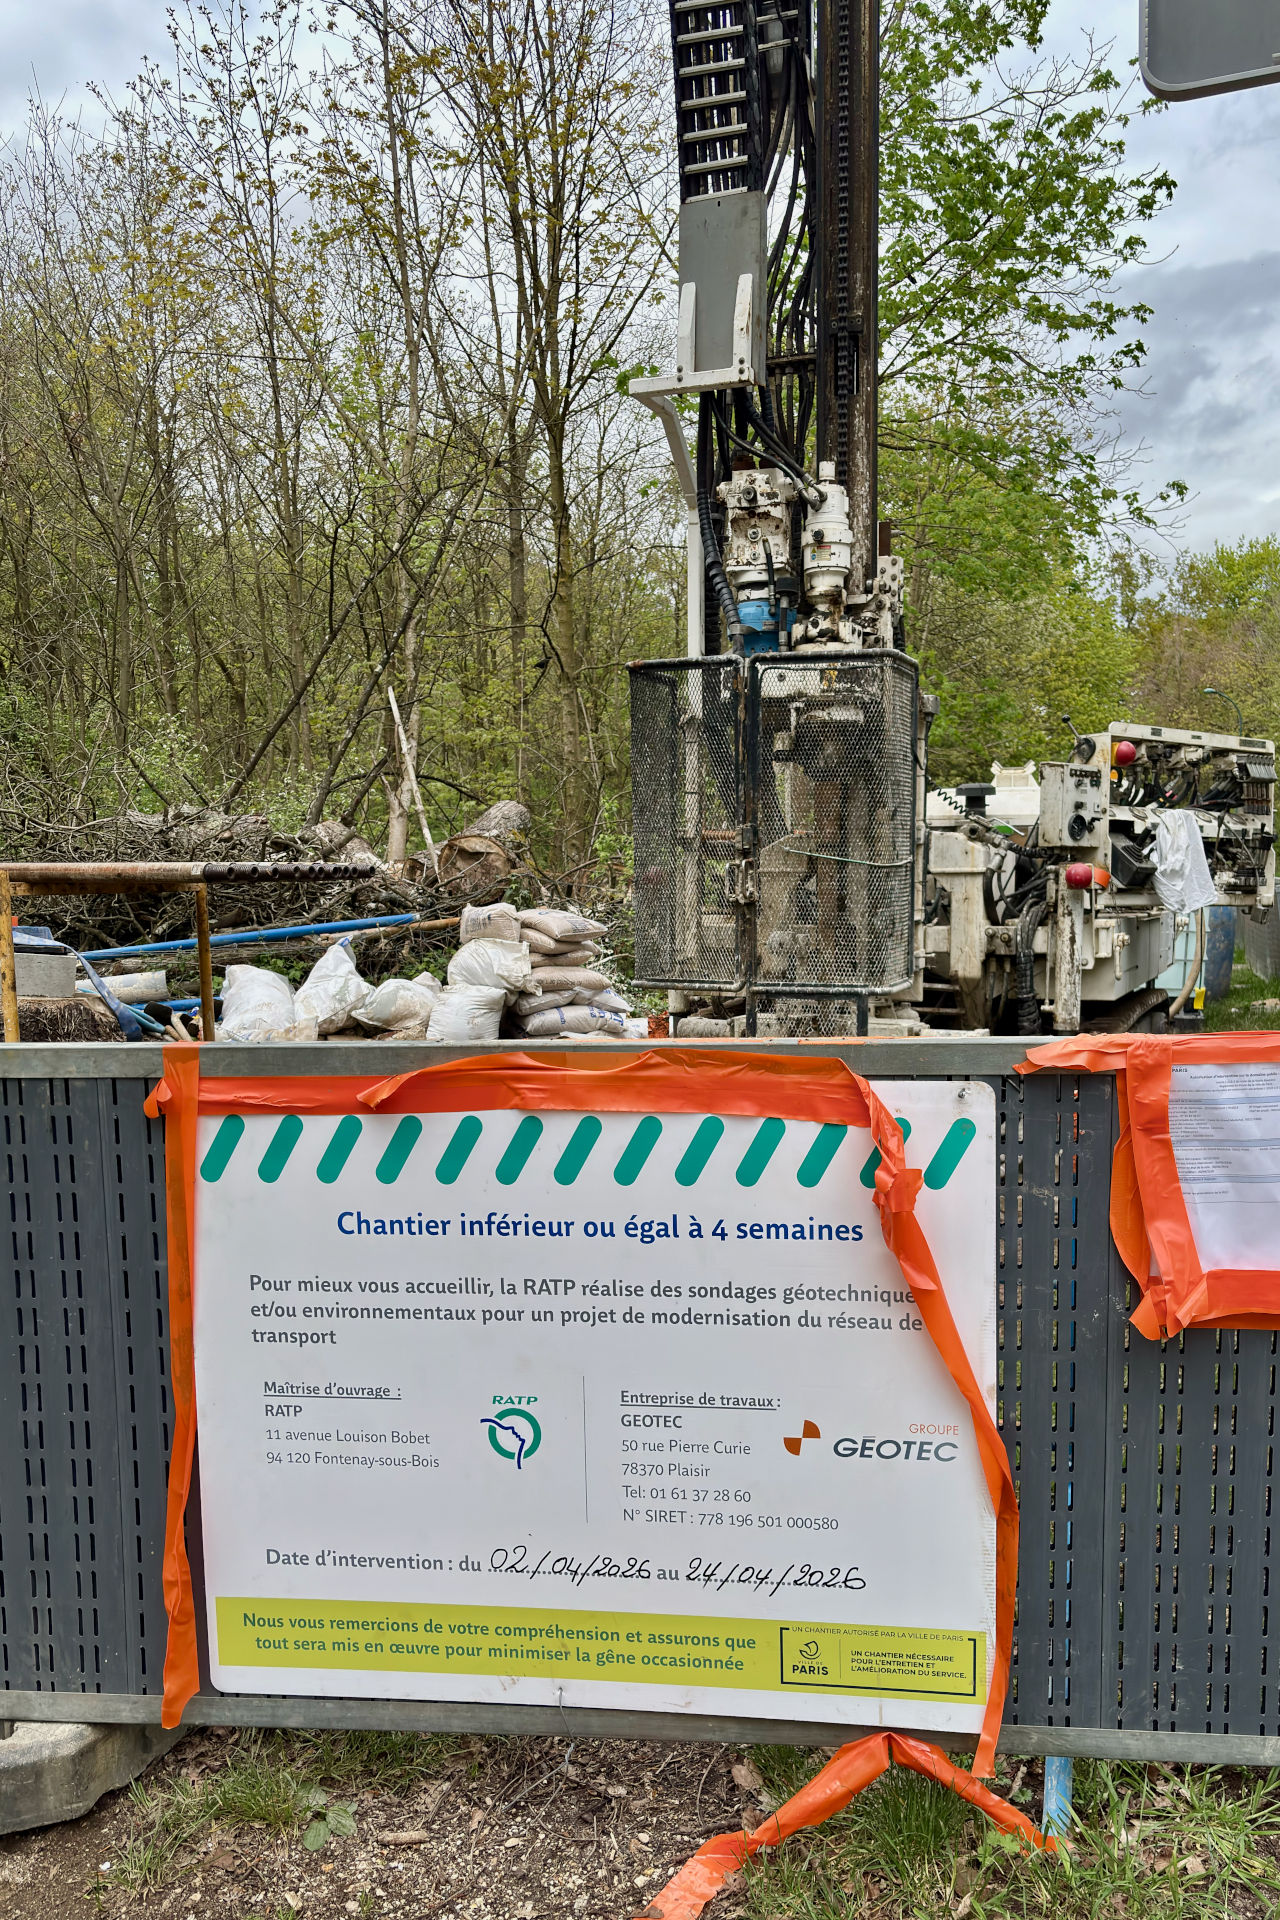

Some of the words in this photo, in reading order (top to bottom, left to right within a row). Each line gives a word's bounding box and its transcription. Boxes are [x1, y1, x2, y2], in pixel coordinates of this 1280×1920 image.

[338, 1211, 451, 1235] Chantier
[461, 1212, 575, 1237] inférieur
[584, 1221, 615, 1237] ou
[624, 1214, 679, 1244] égal
[689, 1215, 704, 1238] à
[712, 1219, 728, 1241] 4
[737, 1216, 863, 1241] semaines
[250, 1275, 291, 1291] Pour
[298, 1275, 353, 1292] mieux
[358, 1281, 399, 1293] vous
[406, 1277, 493, 1297] accueillir,
[501, 1277, 517, 1295] la
[524, 1279, 575, 1295] RATP
[581, 1279, 644, 1297] réalise
[651, 1280, 682, 1297] des
[688, 1281, 776, 1303] sondages
[783, 1283, 916, 1308] géotechnique
[251, 1301, 296, 1317] et/ou
[303, 1303, 476, 1320] environnementaux
[482, 1309, 524, 1325] pour
[532, 1310, 553, 1322] un
[561, 1306, 616, 1327] projet
[623, 1306, 644, 1323] de
[652, 1307, 790, 1326] modernisation
[798, 1310, 822, 1327] du
[828, 1312, 892, 1330] réseau
[899, 1313, 922, 1330] de
[251, 1329, 336, 1348] transport
[264, 1380, 320, 1397] Maîtrise
[492, 1396, 538, 1405] RATP
[620, 1390, 695, 1407] Entreprise
[699, 1392, 715, 1405] de
[265, 1405, 302, 1417] RATP
[621, 1414, 682, 1428] GEOTEC
[266, 1429, 281, 1439] 11
[286, 1432, 331, 1441] avenue
[337, 1429, 386, 1443] Louison
[392, 1431, 430, 1444] Bobet
[909, 1424, 958, 1435] GROUPE
[622, 1440, 638, 1452] 50
[642, 1443, 664, 1452] rue
[670, 1440, 709, 1453] Pierre
[714, 1441, 750, 1454] Curie
[267, 1452, 283, 1463] 94
[287, 1453, 310, 1463] 120
[315, 1452, 439, 1468] Fontenay-sous-Bois
[622, 1462, 663, 1476] 78370
[669, 1463, 710, 1477] Plaisir
[622, 1485, 645, 1498] Tel:
[650, 1488, 666, 1499] 01
[671, 1488, 687, 1500] 61
[693, 1490, 708, 1502] 37
[714, 1489, 729, 1501] 28
[734, 1490, 751, 1502] 60
[646, 1510, 687, 1523] SIRET
[698, 1513, 723, 1525] 778
[729, 1514, 753, 1527] 196
[758, 1516, 782, 1528] 501
[787, 1517, 838, 1530] 000580
[266, 1549, 309, 1565] Date
[459, 1555, 482, 1572] du
[657, 1569, 679, 1580] au
[244, 1613, 284, 1627] Nous
[289, 1619, 324, 1629] vous
[330, 1617, 418, 1632] remercions
[424, 1619, 443, 1633] de
[448, 1623, 489, 1635] votre
[495, 1624, 619, 1641] compréhension
[626, 1631, 642, 1643] et
[648, 1634, 719, 1647] assurons
[725, 1638, 756, 1652] que
[805, 1627, 842, 1635] CHANTIER
[843, 1629, 880, 1637] AUTORISÉ
[255, 1637, 289, 1649] tout
[294, 1640, 326, 1650] sera
[332, 1638, 359, 1652] mis
[365, 1643, 383, 1652] en
[390, 1644, 439, 1655] œuvre
[445, 1646, 482, 1659] pour
[489, 1644, 570, 1660] minimiser
[576, 1647, 591, 1662] la
[596, 1649, 635, 1666] gêne
[641, 1653, 744, 1670] occasionnée
[865, 1651, 904, 1660] CHANTIER
[906, 1653, 955, 1663] NÉCESSAIRE
[792, 1665, 828, 1675] PARIS
[932, 1671, 967, 1679] SERVICE.
